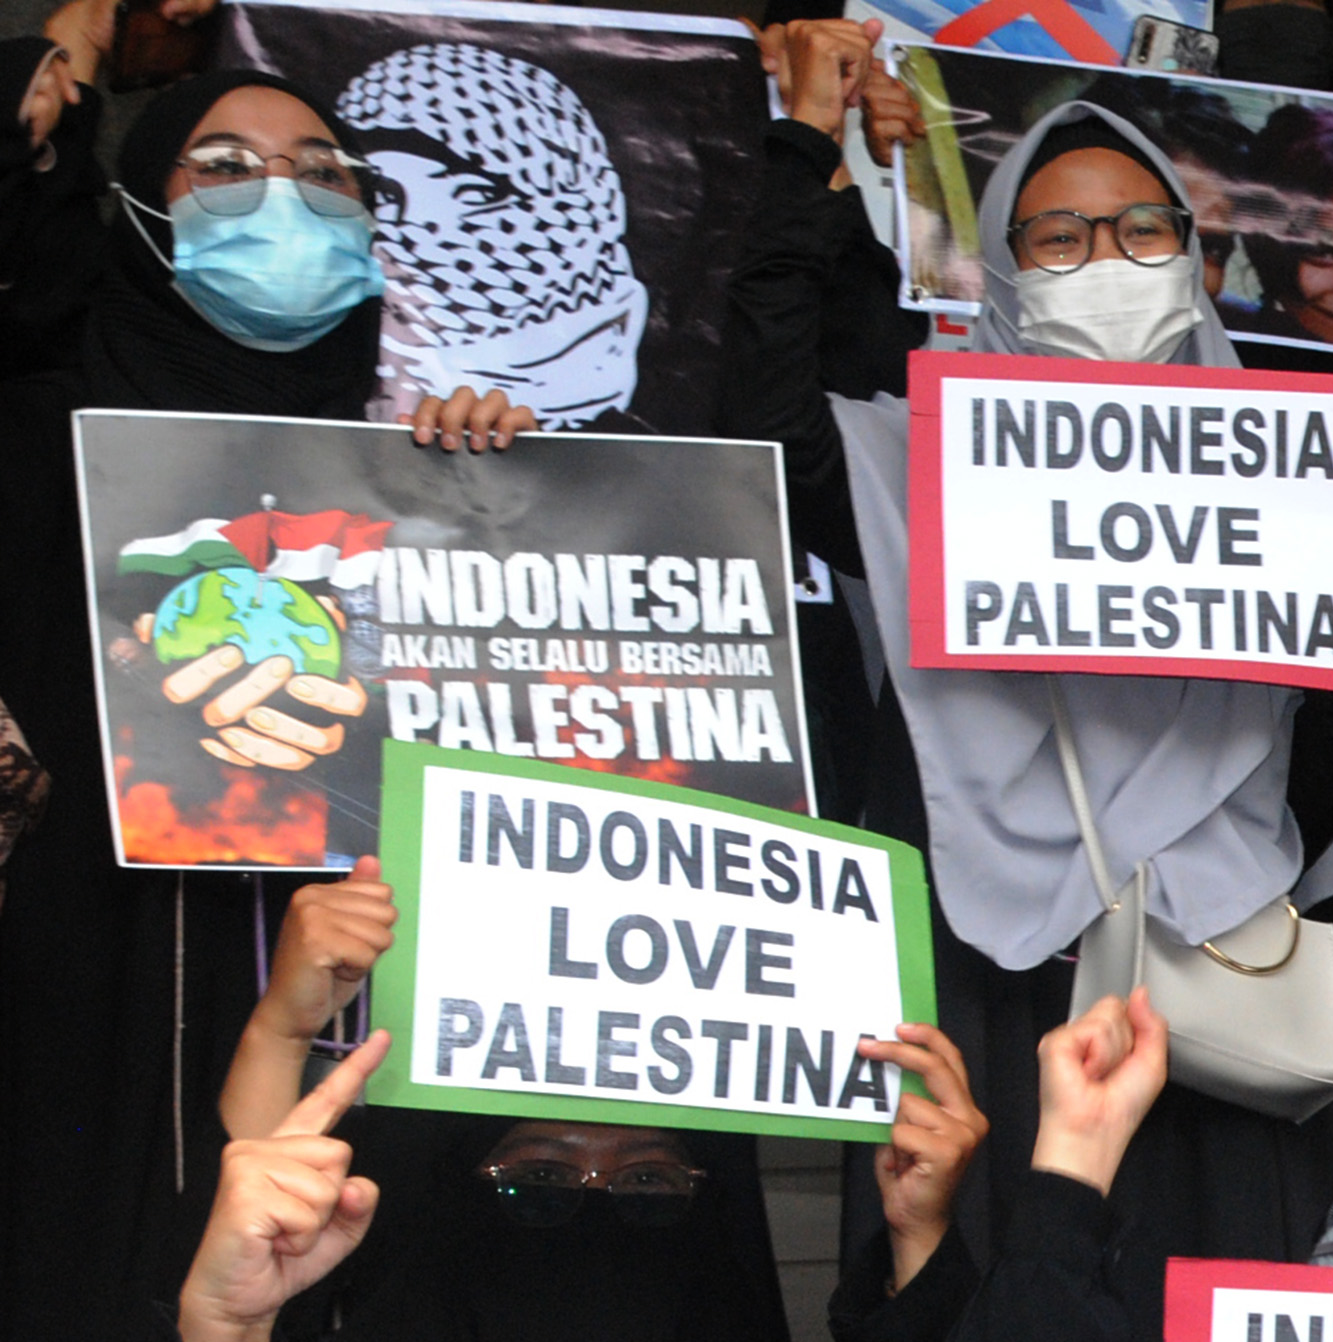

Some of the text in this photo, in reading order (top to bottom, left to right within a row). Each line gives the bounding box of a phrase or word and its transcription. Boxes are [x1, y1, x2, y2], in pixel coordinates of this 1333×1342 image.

[1051, 499, 1263, 567] LOVE
[380, 548, 773, 635] INDONESIA
[381, 637, 773, 677] AKAN SELALU BERSAMA
[387, 678, 794, 763] PALESTINA
[457, 790, 879, 922] INDONESIA
[548, 906, 797, 998] LOVE
[434, 998, 890, 1113] PALESTINA
